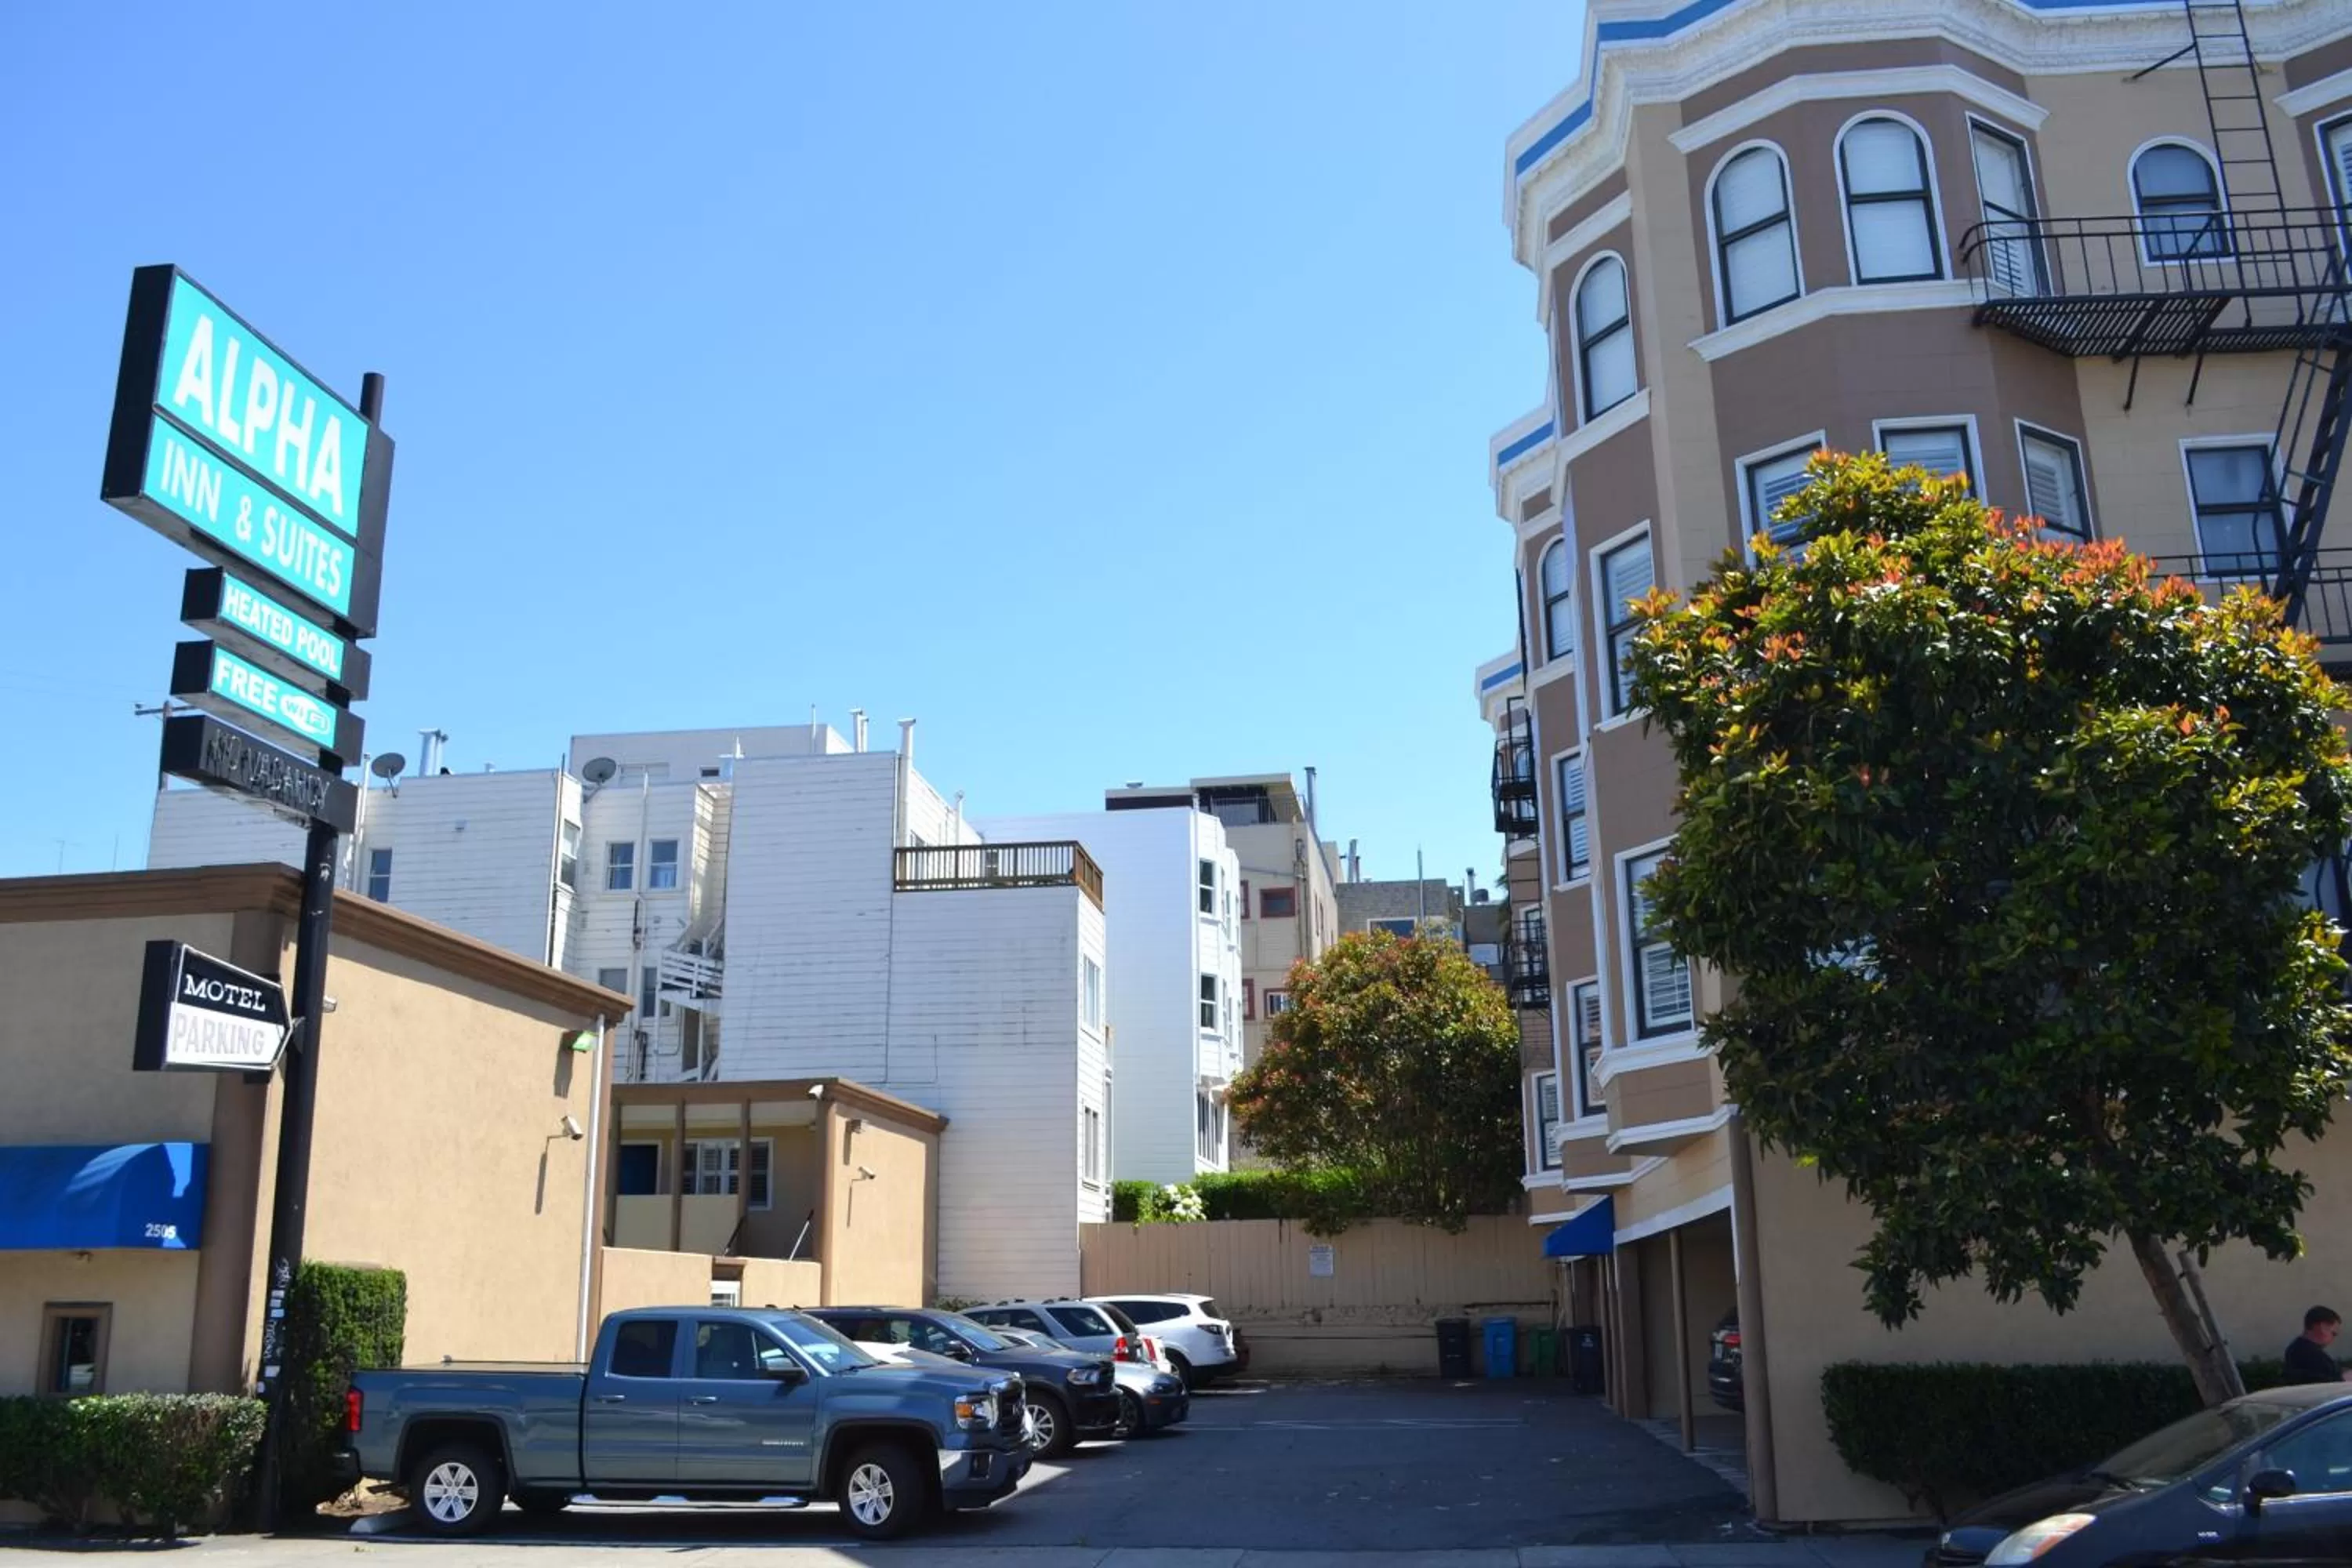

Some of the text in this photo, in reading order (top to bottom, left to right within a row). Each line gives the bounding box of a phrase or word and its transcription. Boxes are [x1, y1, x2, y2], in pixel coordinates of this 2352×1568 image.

[173, 313, 343, 517] ALPHA
[161, 439, 343, 597] INN & SUITES
[224, 583, 338, 673] HEATED POOL
[216, 656, 278, 716] FREE
[184, 975, 265, 1012] MOTEL
[172, 1013, 264, 1056] PARKING
